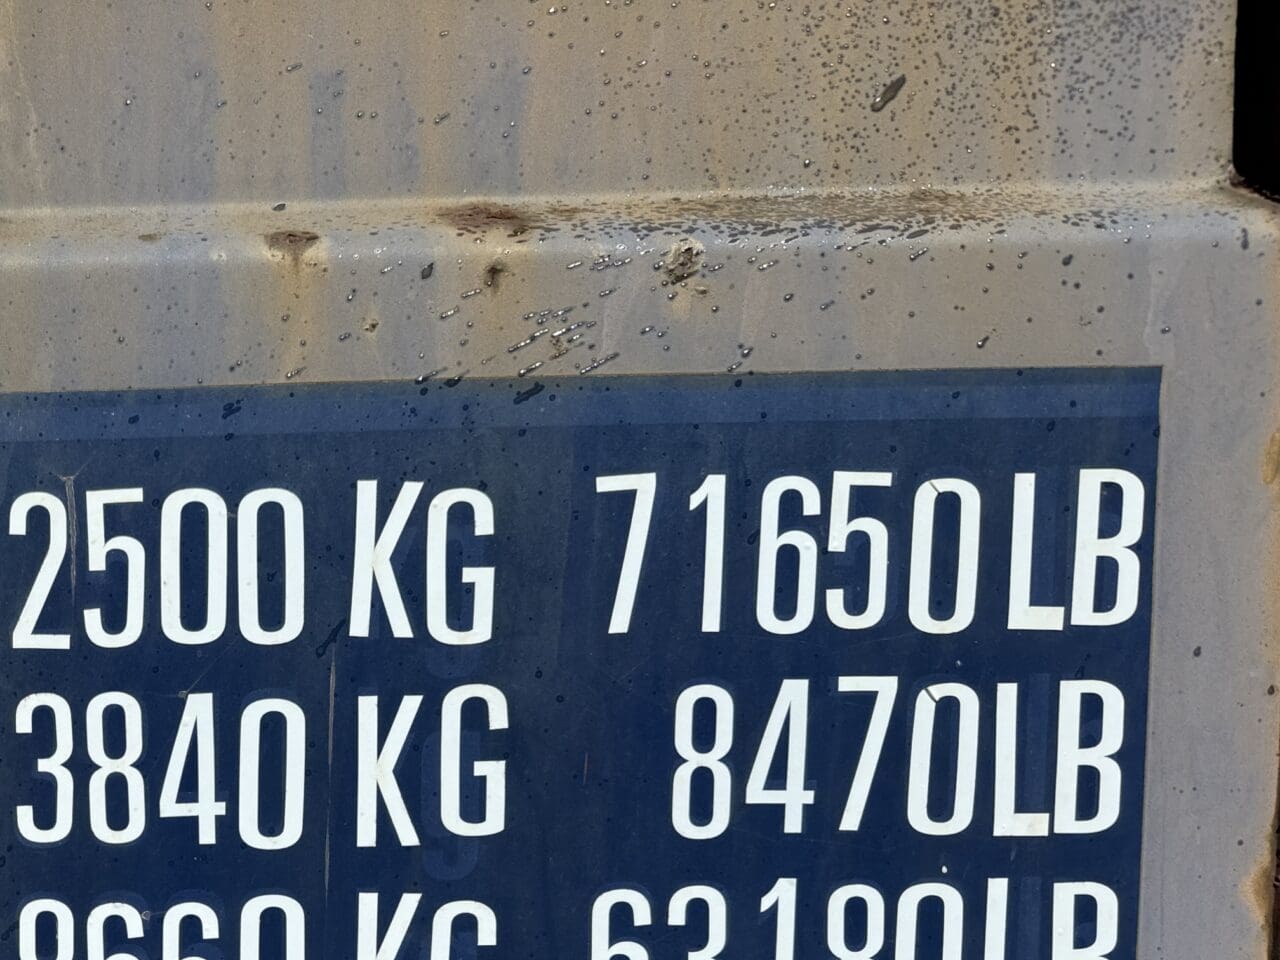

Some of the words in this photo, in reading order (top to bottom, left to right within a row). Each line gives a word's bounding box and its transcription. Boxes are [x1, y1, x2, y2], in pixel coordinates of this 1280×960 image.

[348, 479, 496, 646] KG
[594, 469, 981, 635] 71650
[14, 689, 307, 850] 3840
[356, 683, 510, 848] KG
